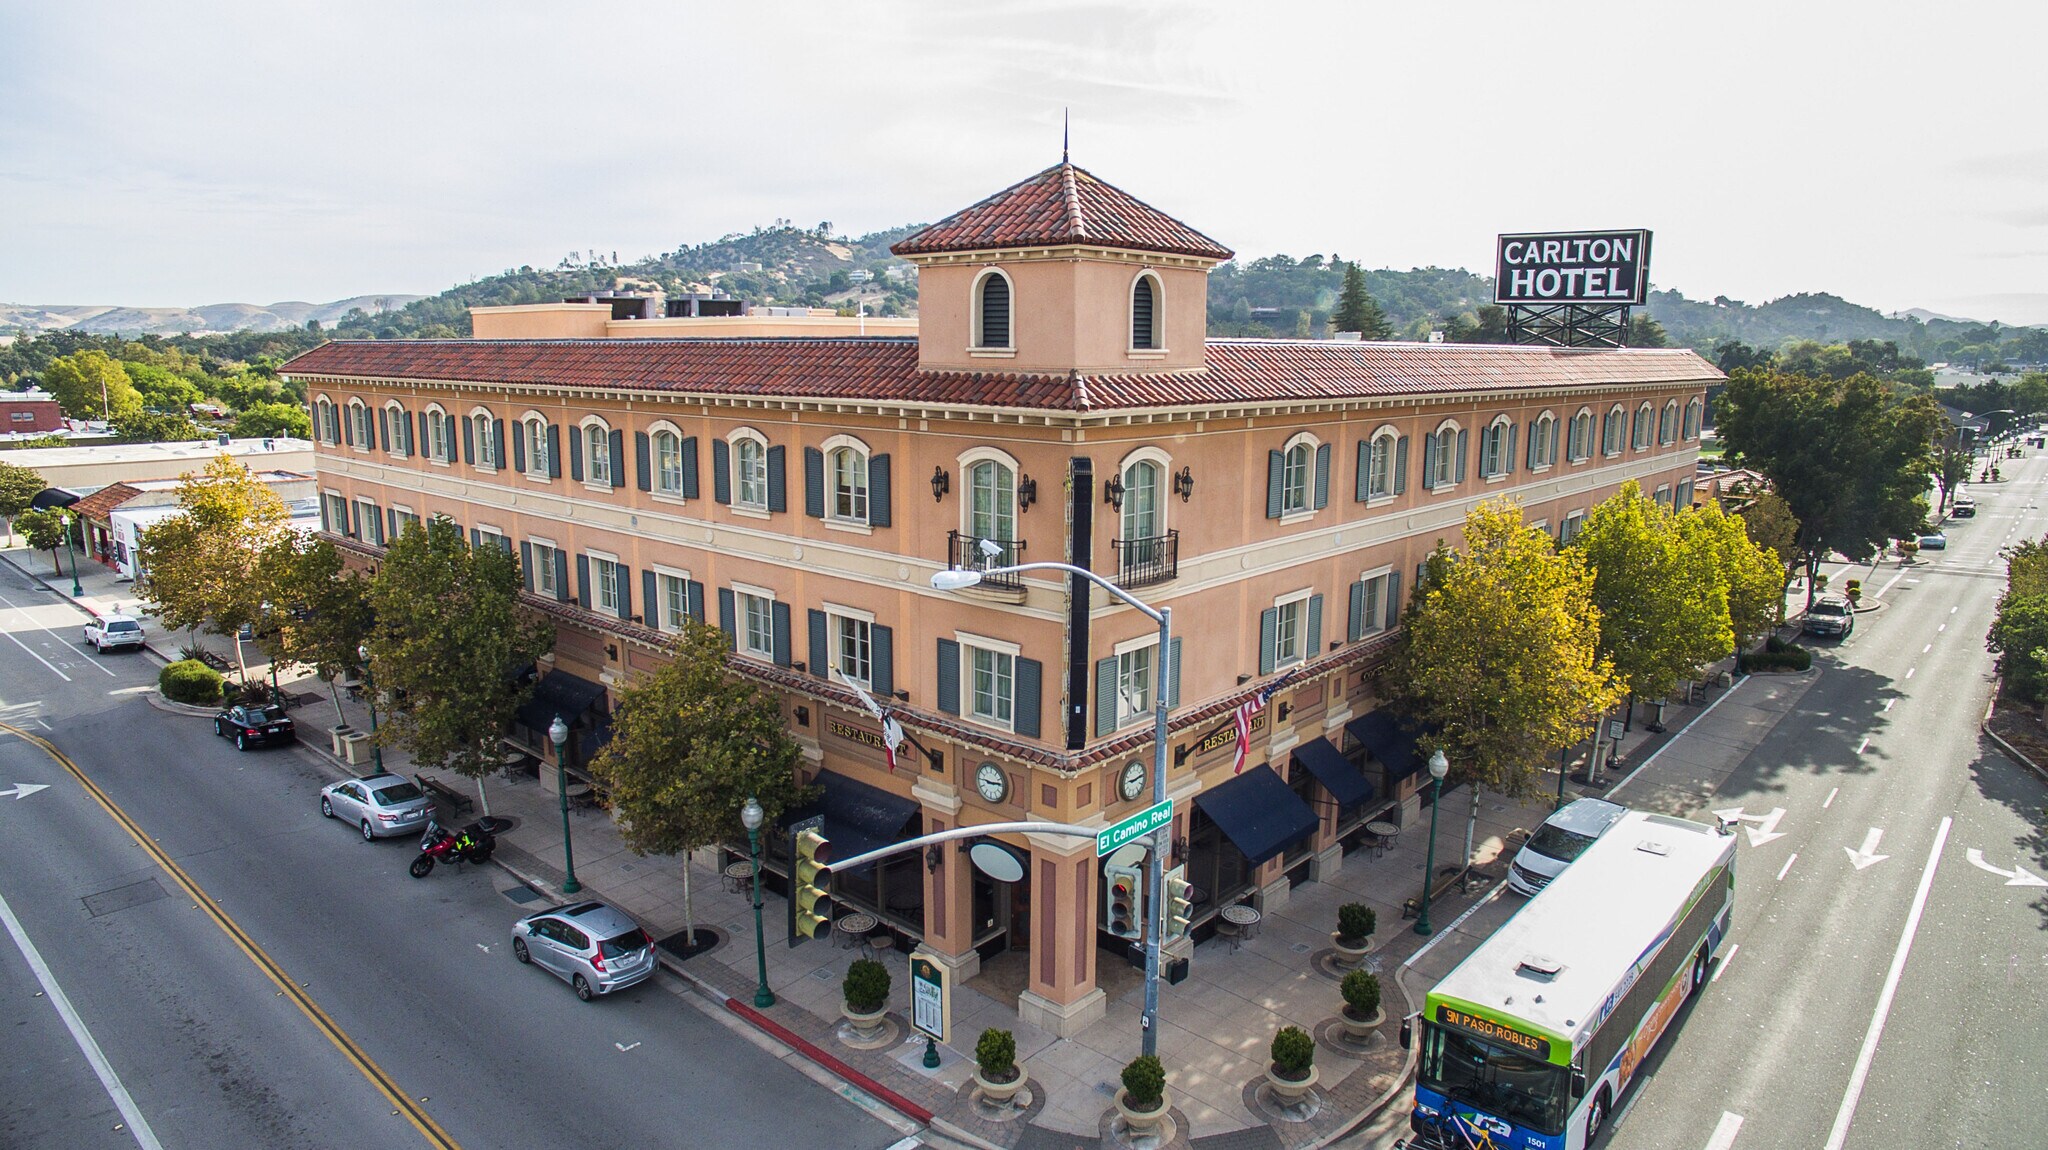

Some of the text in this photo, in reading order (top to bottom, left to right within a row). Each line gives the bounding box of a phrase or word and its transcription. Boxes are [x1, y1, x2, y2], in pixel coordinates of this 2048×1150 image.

[1504, 238, 1633, 265] CARLTON
[1509, 267, 1629, 298] HOTEL
[828, 720, 906, 756] RESTAURT
[1203, 716, 1265, 752] RESTAANT
[1100, 834, 1110, 850] El
[1113, 818, 1148, 843] Camino
[1151, 805, 1171, 825] Real
[1446, 1009, 1539, 1050] 9N PASO ROBLES
[1527, 1136, 1546, 1149] 1501
